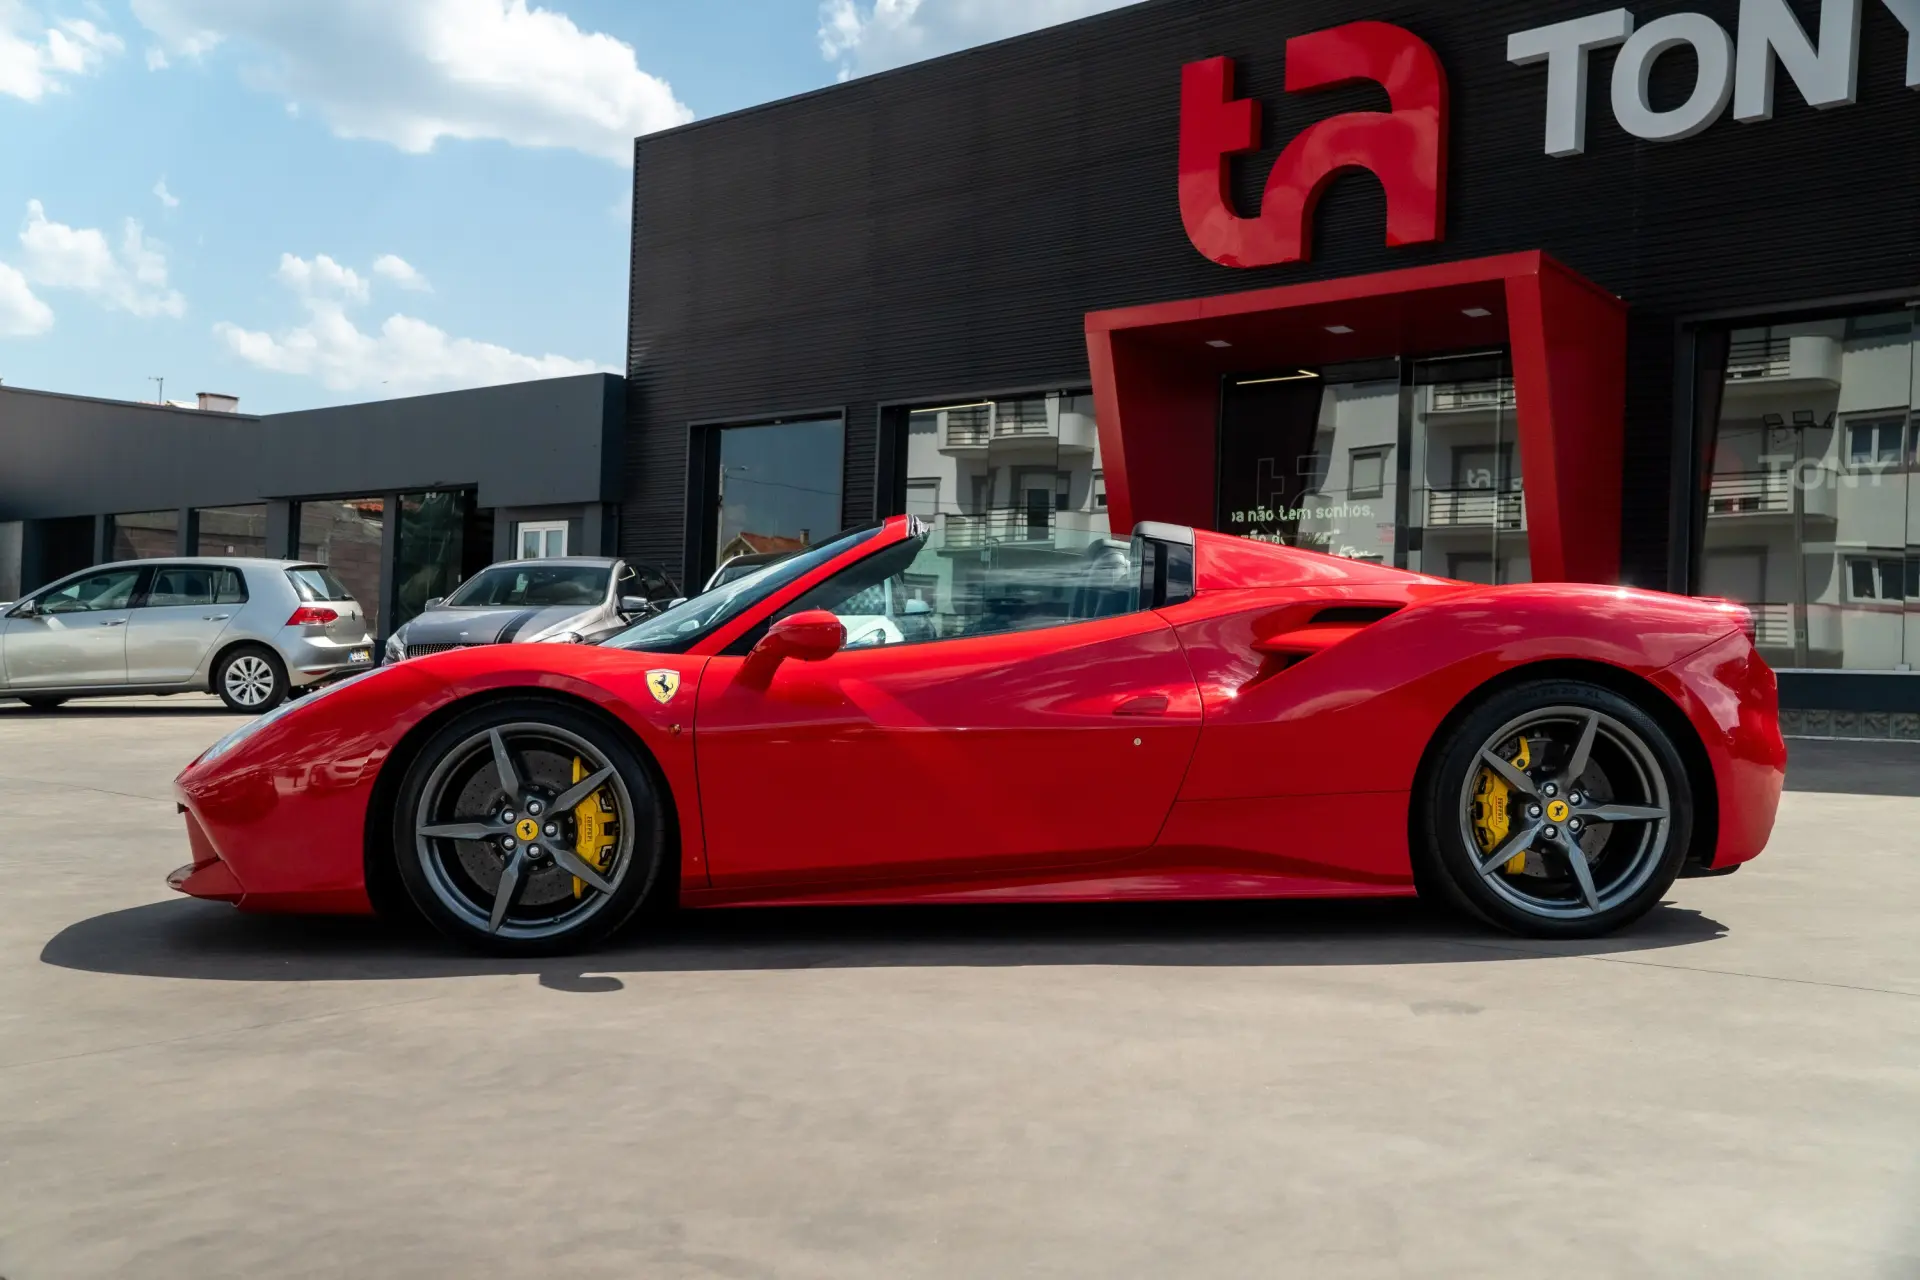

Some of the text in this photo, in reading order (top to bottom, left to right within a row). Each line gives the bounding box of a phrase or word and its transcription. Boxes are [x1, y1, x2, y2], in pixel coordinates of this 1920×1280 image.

[1758, 454, 1896, 490] TONY
[1247, 505, 1274, 522] não
[1279, 505, 1311, 521] tem
[1316, 501, 1375, 519] sonhos,
